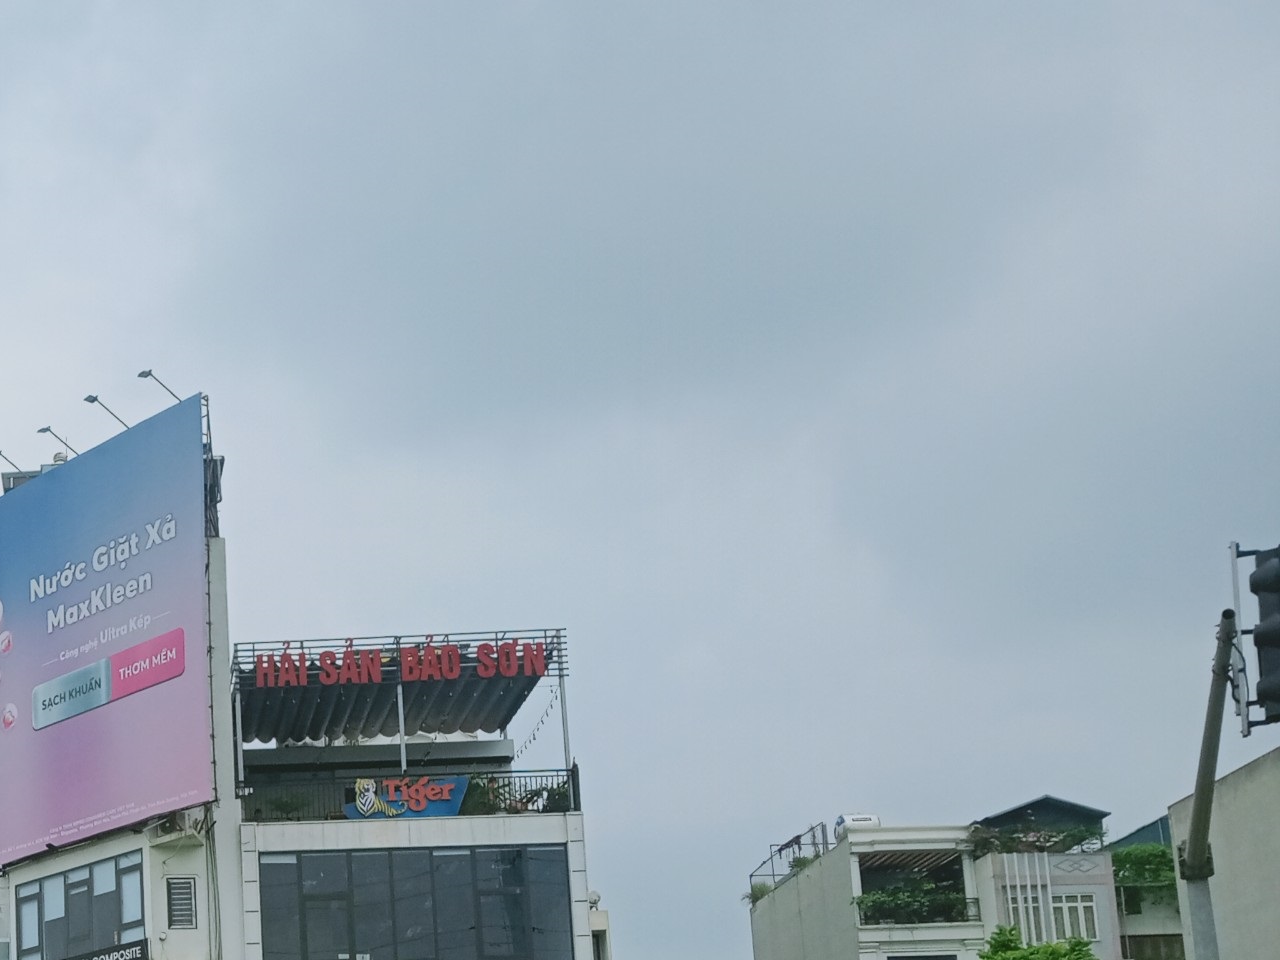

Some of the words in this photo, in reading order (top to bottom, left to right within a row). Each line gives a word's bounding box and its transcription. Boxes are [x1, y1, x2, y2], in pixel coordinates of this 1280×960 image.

[29, 561, 87, 603] Nước
[91, 531, 140, 572] Giặt
[144, 513, 178, 551] Xả
[46, 571, 154, 634] MaxKleen
[99, 621, 128, 644] Ultra
[128, 613, 152, 632] Kép
[118, 661, 150, 681] THƠM
[255, 640, 308, 688] HẢI
[320, 637, 382, 685] SẢN
[400, 634, 461, 682] BẢO
[476, 637, 547, 680] SƠN
[41, 691, 67, 712] SẠCH
[382, 776, 456, 812] Tiger
